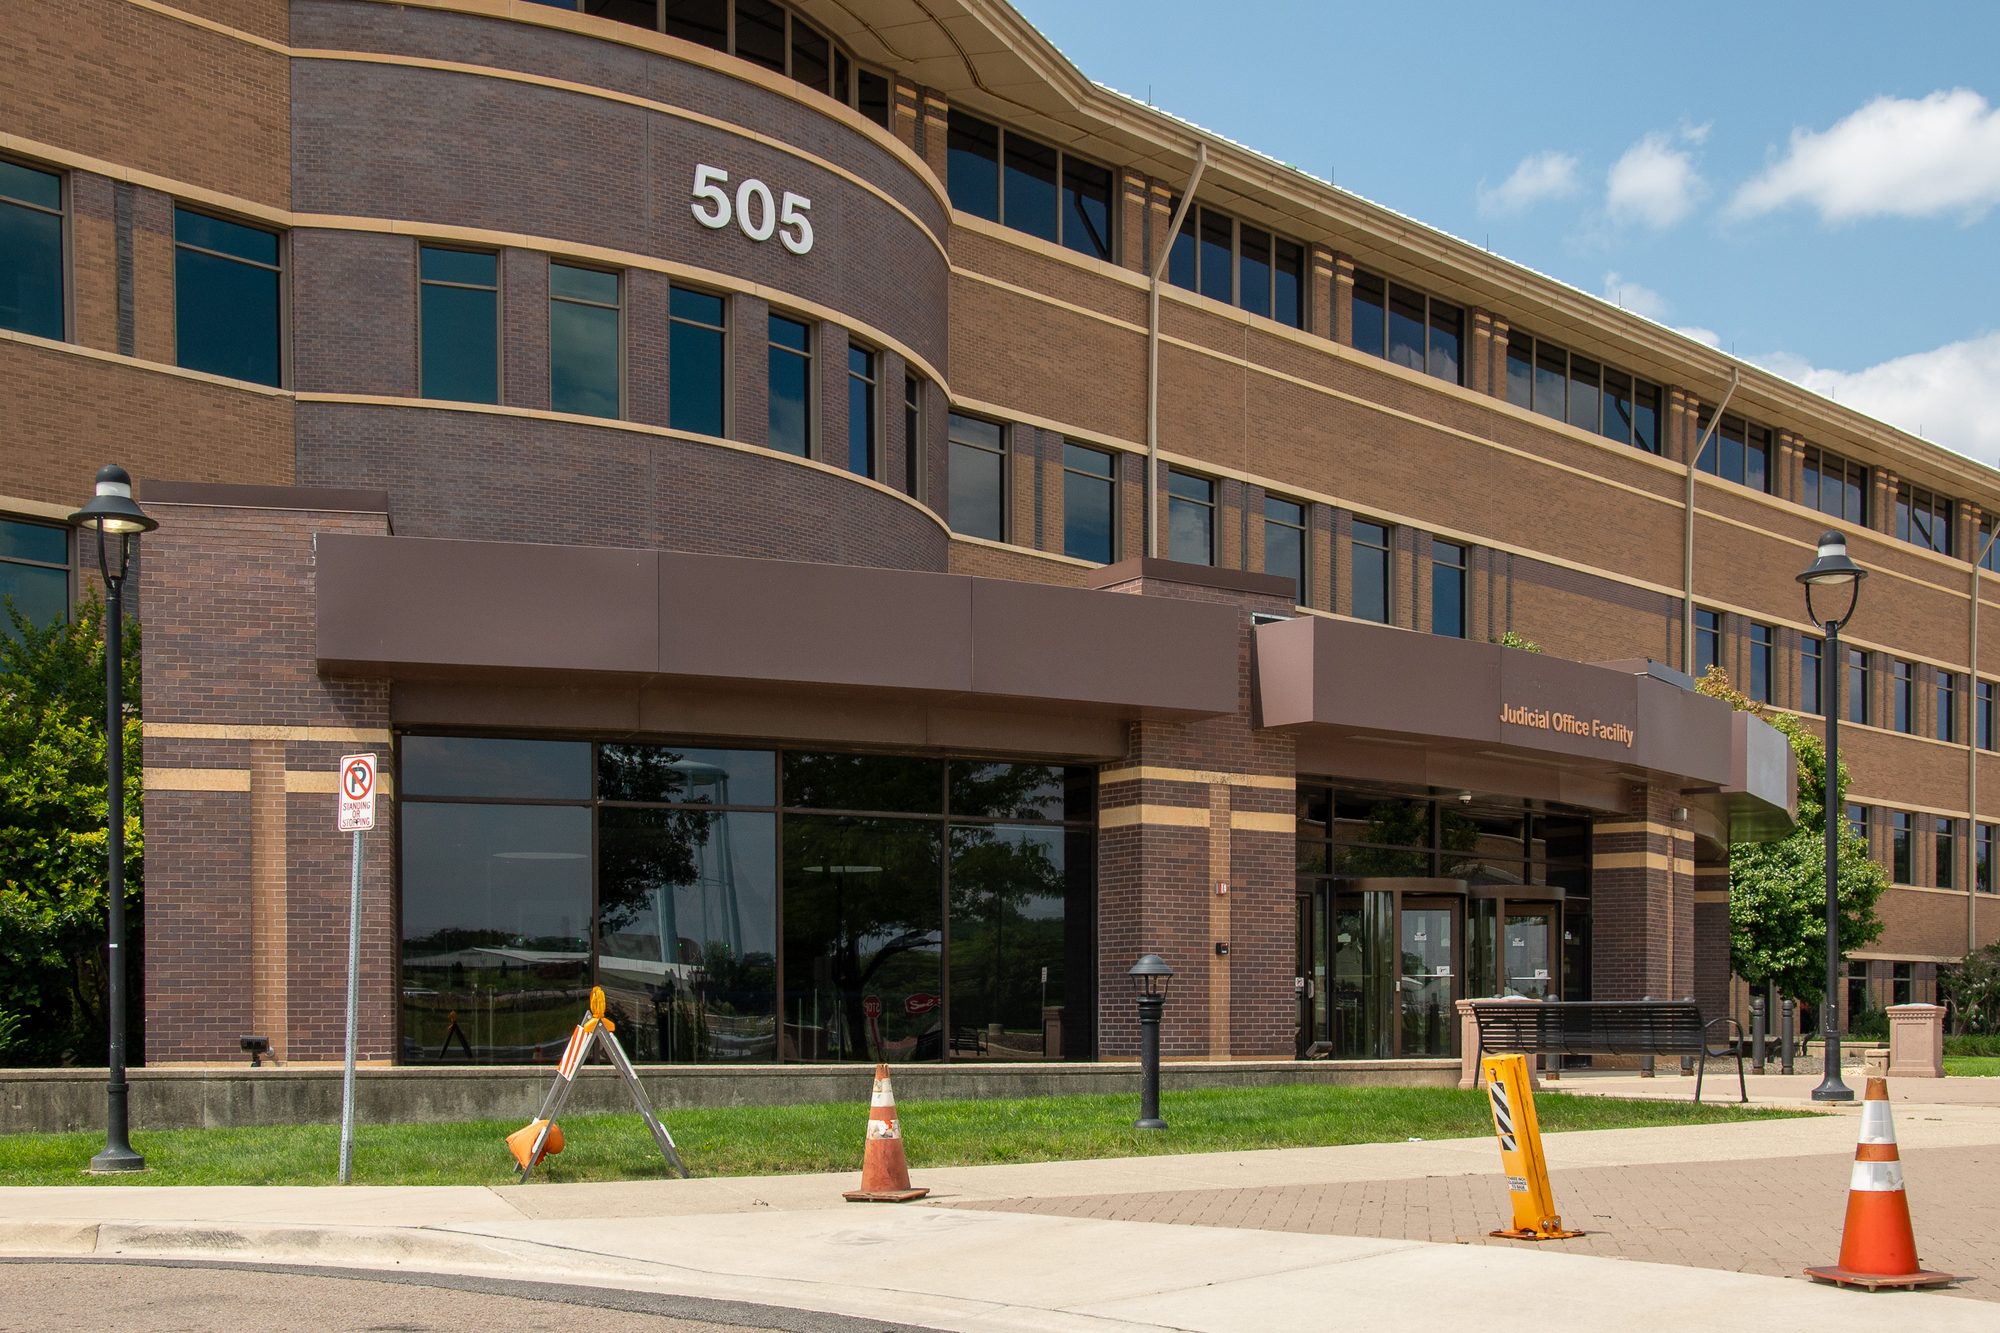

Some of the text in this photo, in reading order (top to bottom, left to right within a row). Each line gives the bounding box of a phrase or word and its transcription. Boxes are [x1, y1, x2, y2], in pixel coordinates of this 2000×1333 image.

[691, 163, 814, 255] 505
[1500, 703, 1634, 748] Judicial Office Facility
[343, 801, 371, 811] STANDING
[352, 809, 361, 818] OR
[342, 817, 370, 827] STOPPING
